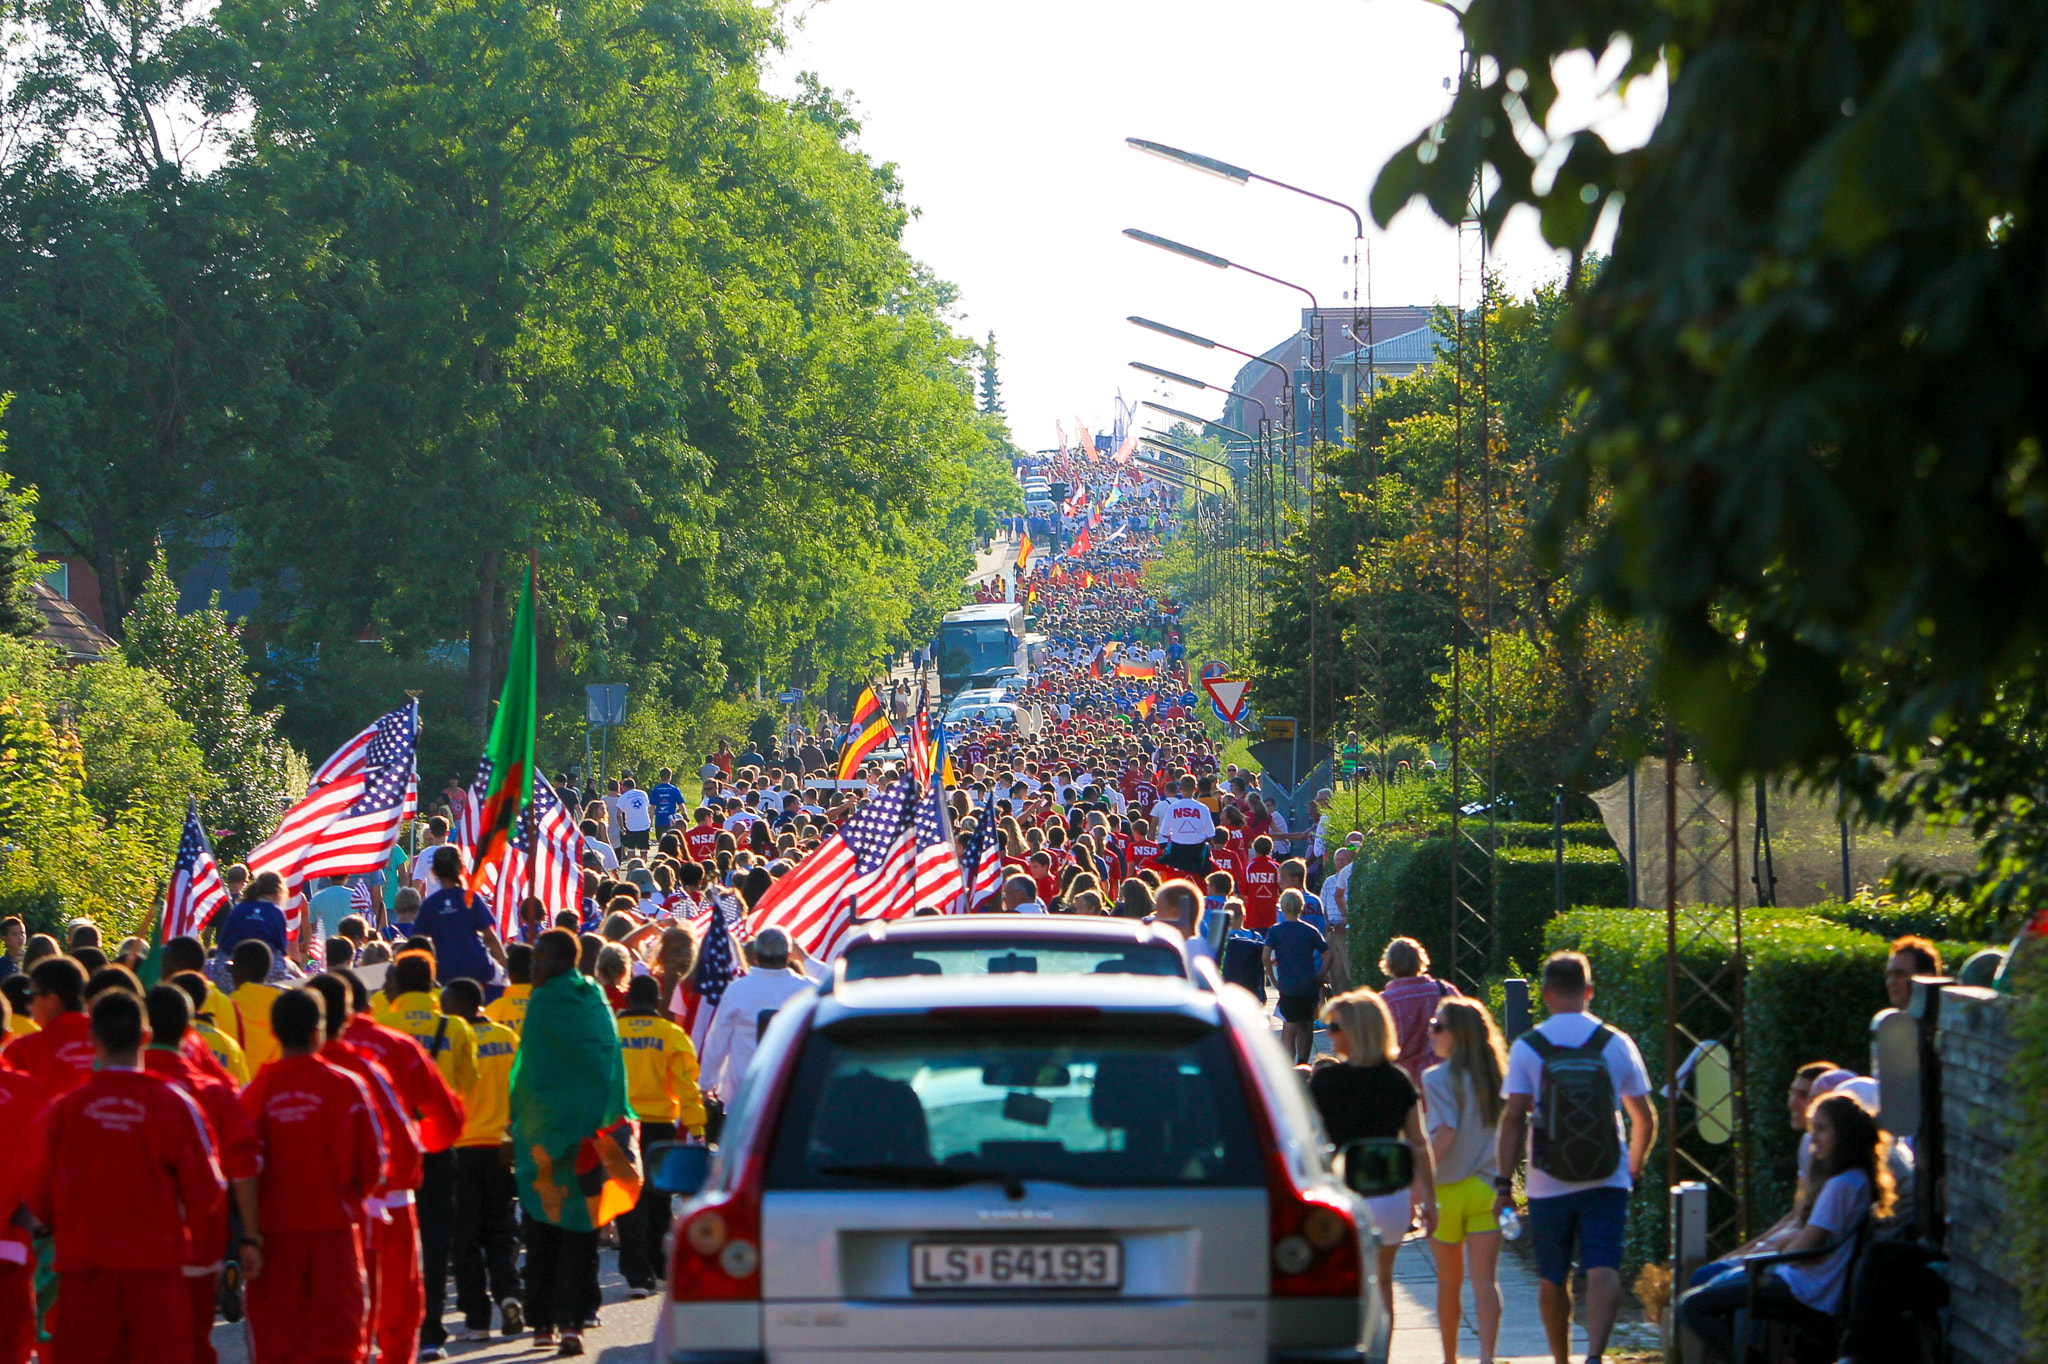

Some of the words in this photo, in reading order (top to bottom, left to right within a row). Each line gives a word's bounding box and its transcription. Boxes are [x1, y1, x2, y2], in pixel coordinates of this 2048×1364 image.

[969, 750, 982, 764] 13
[1137, 790, 1149, 806] 13
[1173, 807, 1201, 819] NSA
[1231, 829, 1243, 839] NS
[1133, 846, 1158, 856] NSA
[1215, 859, 1232, 869] SA
[1250, 872, 1275, 883] NSA
[923, 1250, 969, 1283] LS
[991, 1249, 1107, 1282] 64193
